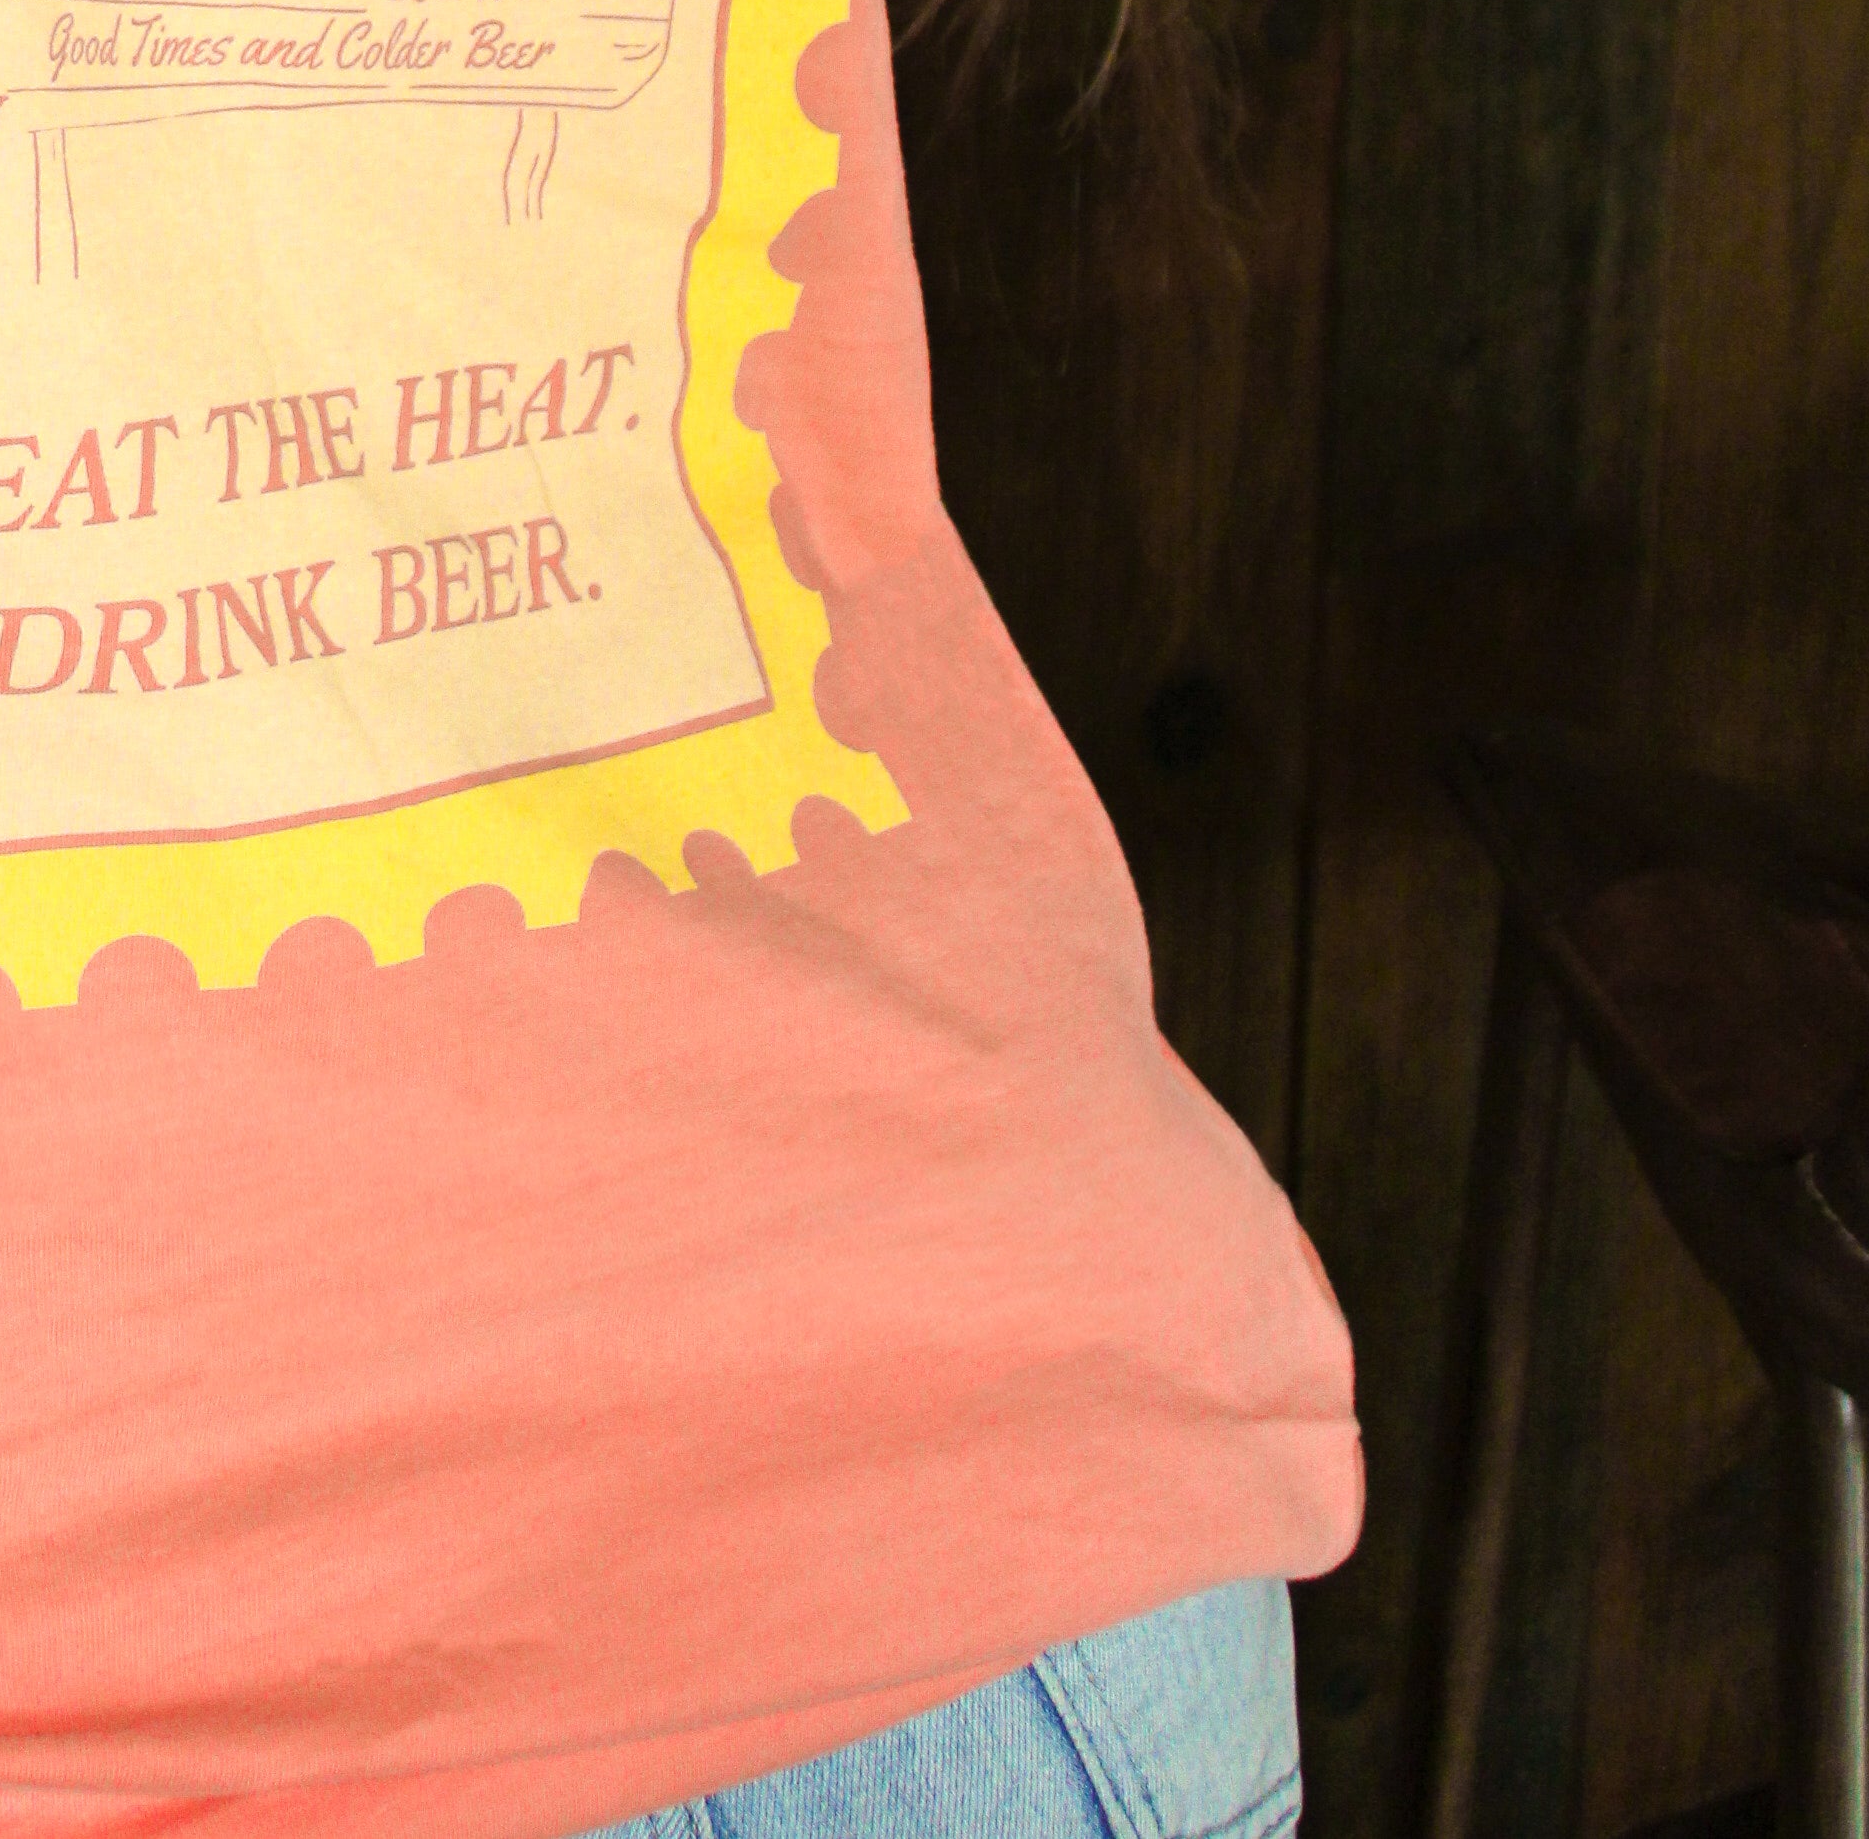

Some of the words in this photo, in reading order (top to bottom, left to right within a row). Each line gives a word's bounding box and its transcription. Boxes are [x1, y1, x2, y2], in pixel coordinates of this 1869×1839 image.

[48, 12, 123, 82] Good
[130, 13, 235, 68] Times
[239, 17, 333, 70] and
[335, 18, 451, 71] Colder
[464, 18, 556, 71] Beer
[205, 387, 366, 504] THE
[391, 343, 640, 472] HEAT.
[372, 515, 603, 646] BEER.
